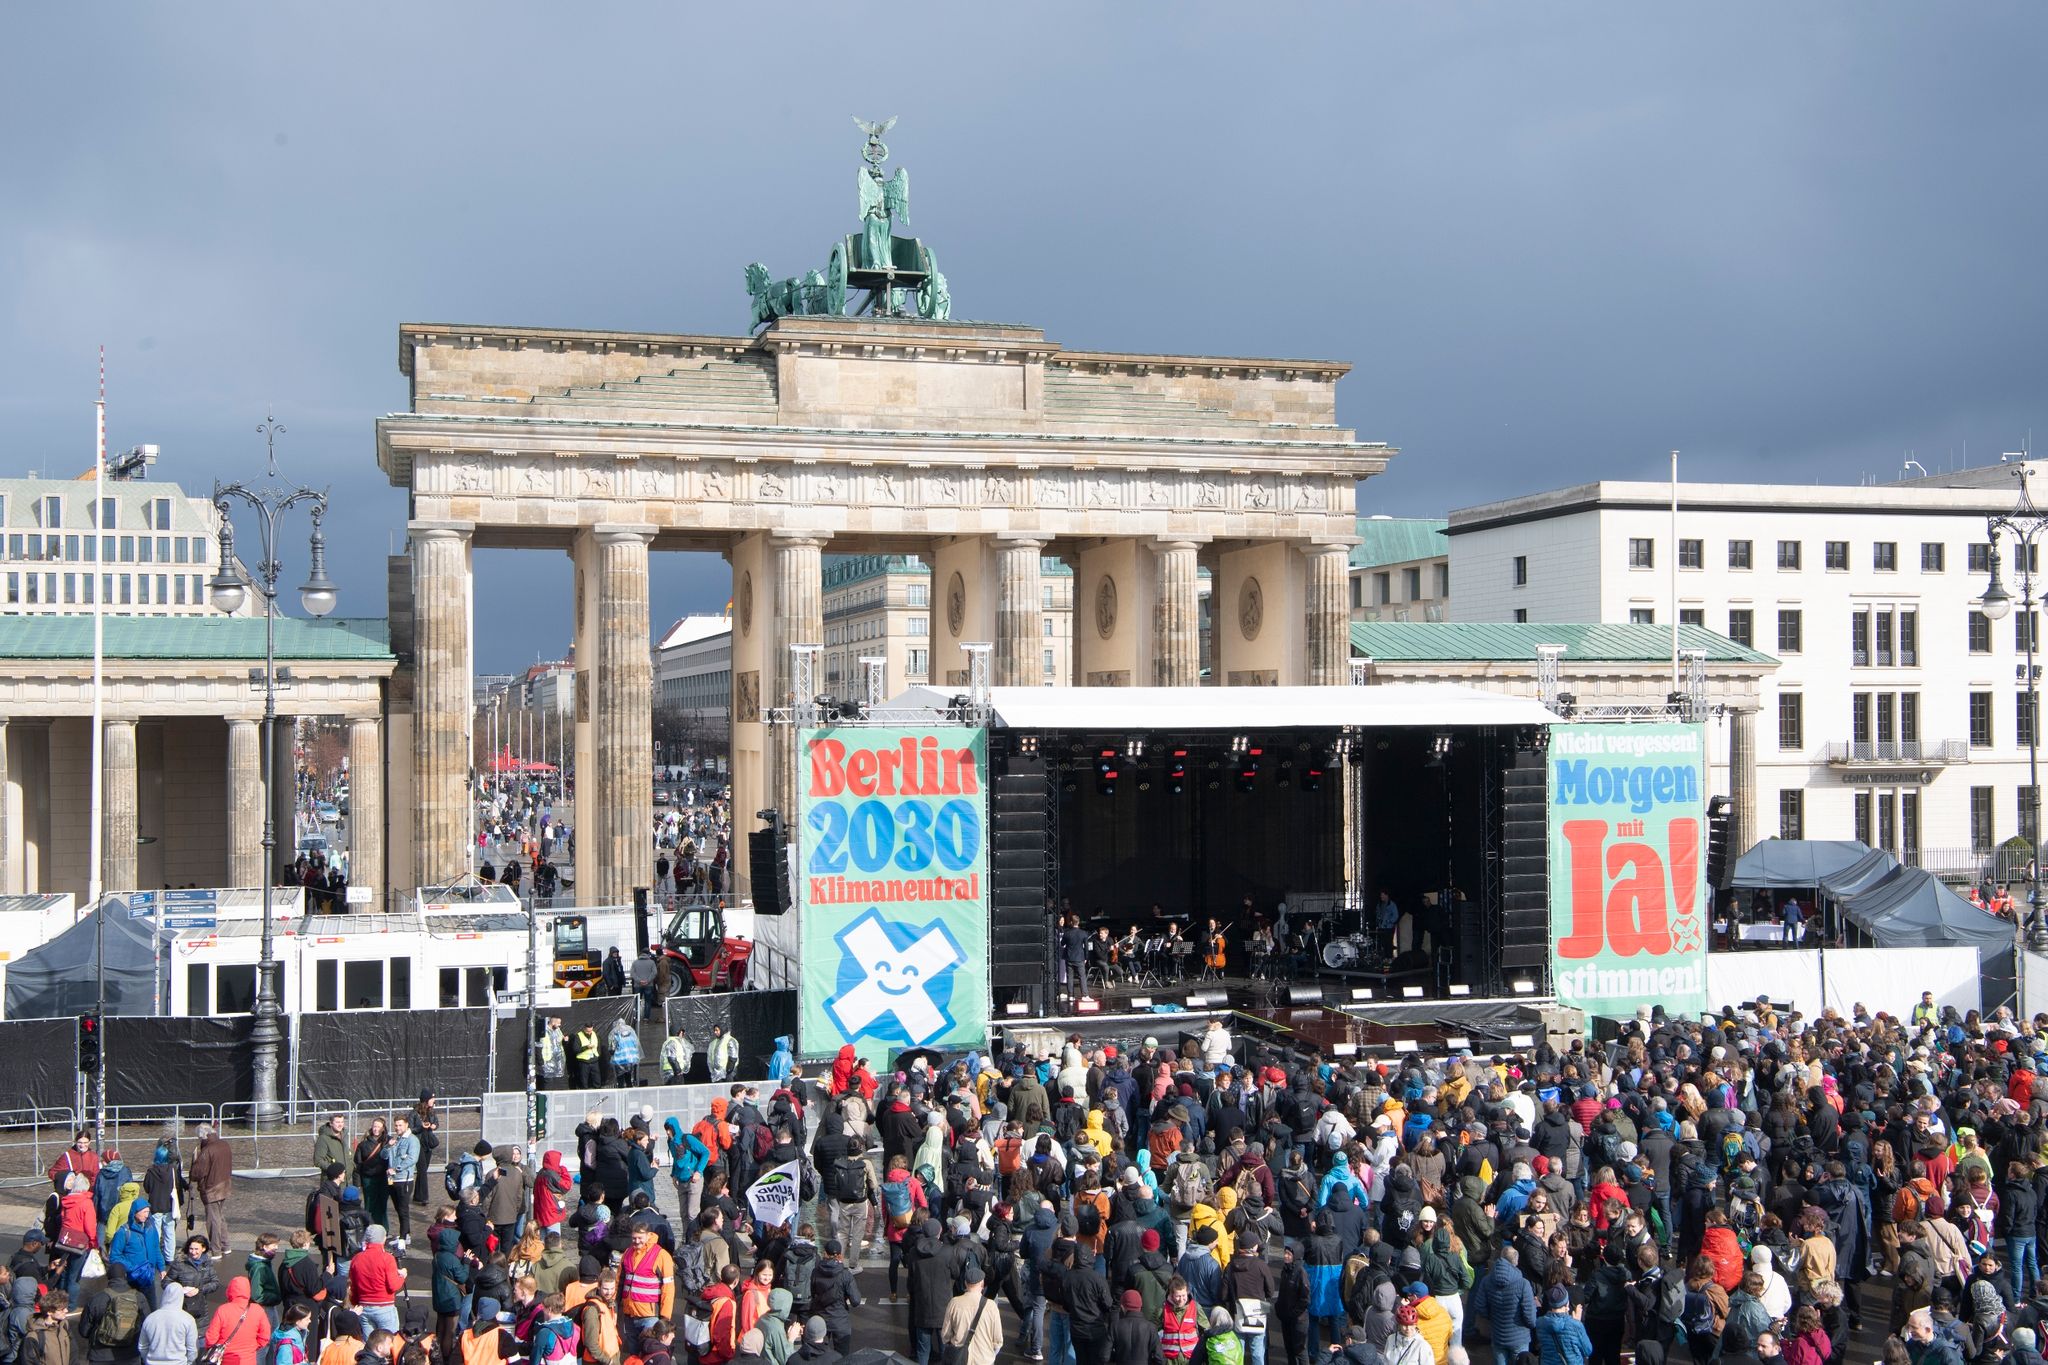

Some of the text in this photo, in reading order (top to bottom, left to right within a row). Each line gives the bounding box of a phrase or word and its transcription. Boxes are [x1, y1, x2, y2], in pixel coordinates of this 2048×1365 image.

[1555, 731, 1698, 757] Nicht vergessen!
[809, 736, 978, 796] Berlin
[1555, 759, 1698, 814] Morgen
[808, 799, 980, 874] 2030
[1616, 818, 1645, 838] mit
[810, 873, 979, 904] Klimaneutral
[1557, 818, 1699, 959] Ja!
[566, 964, 584, 972] JCB
[1558, 960, 1702, 999] stimmen!
